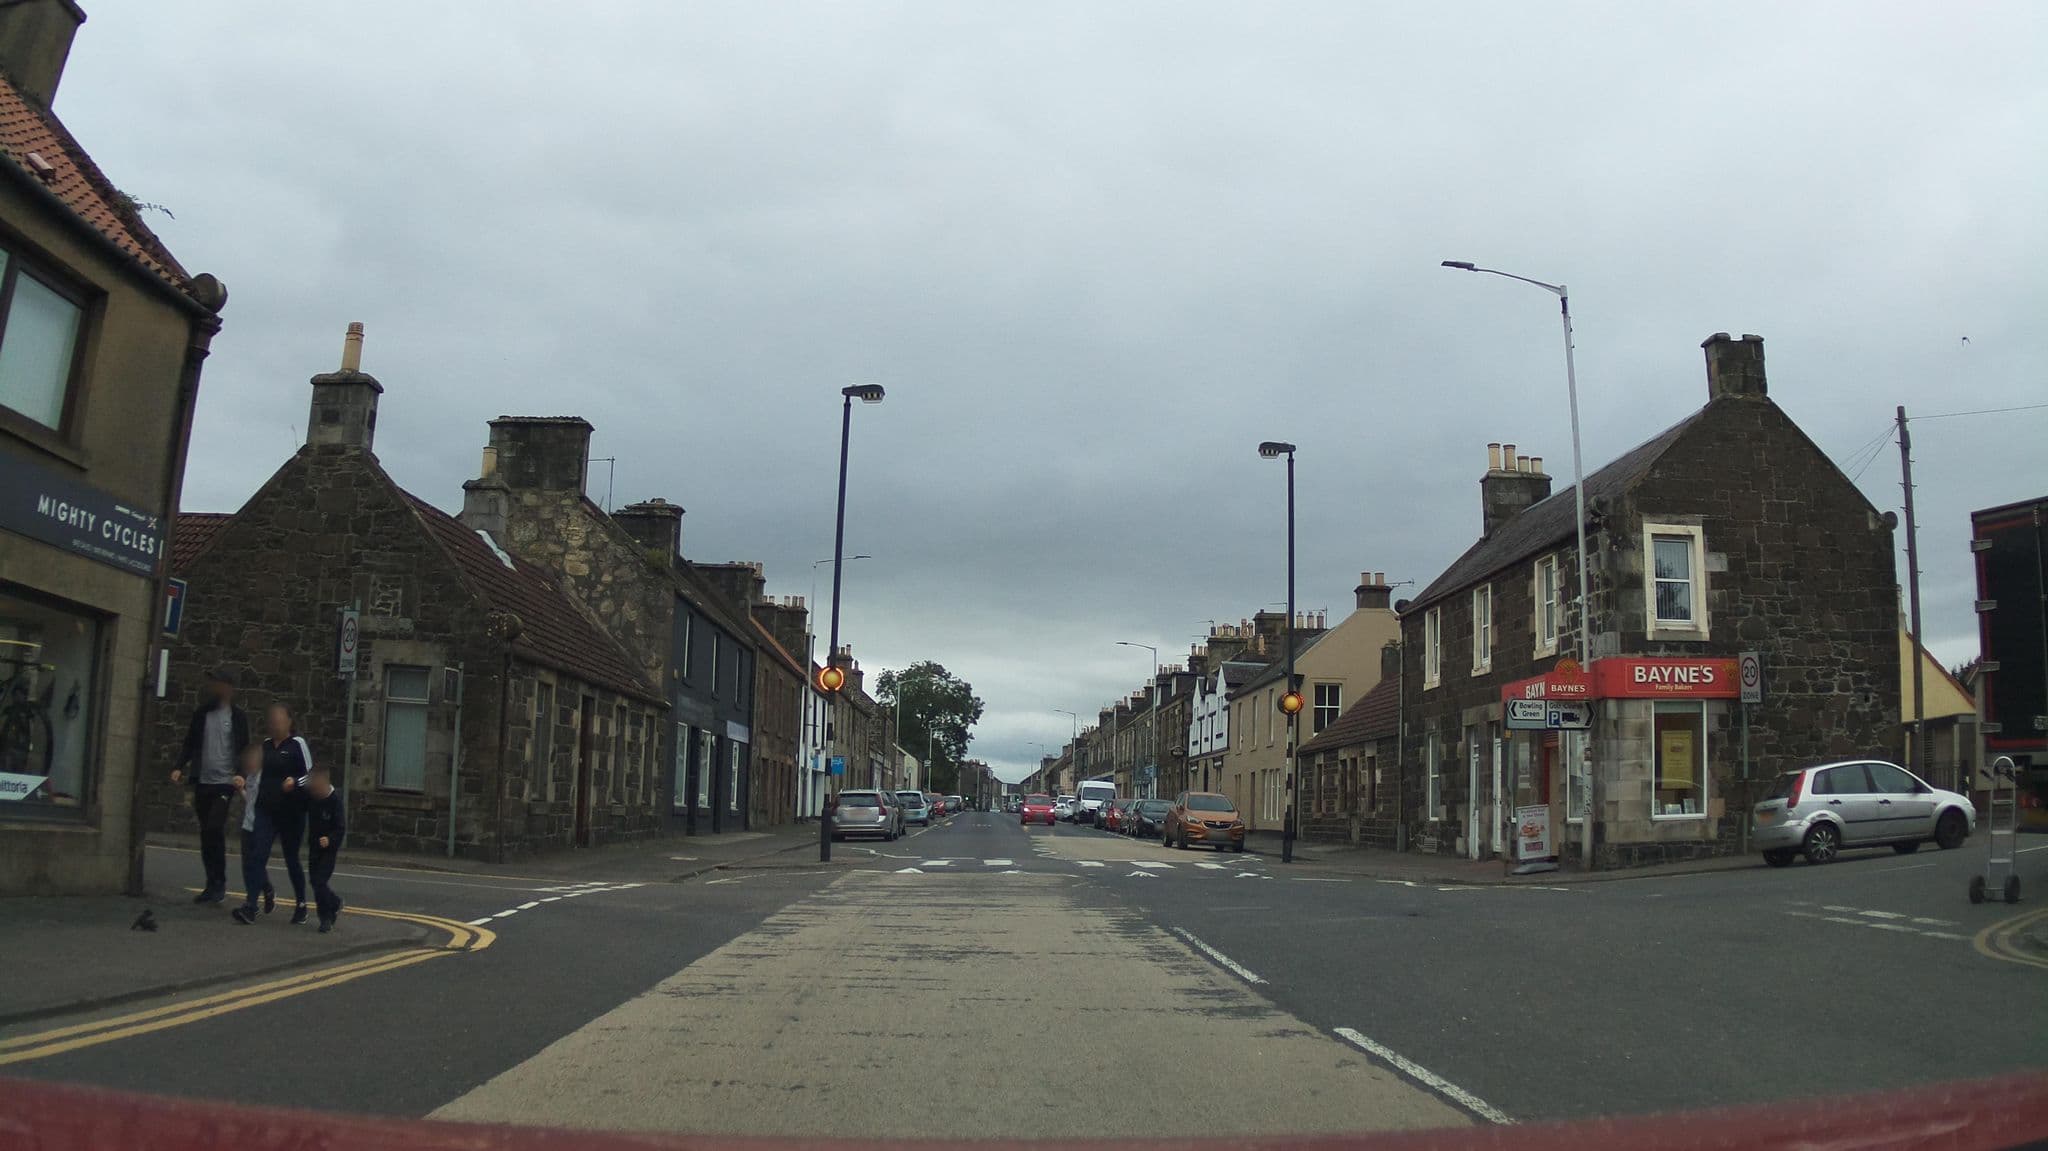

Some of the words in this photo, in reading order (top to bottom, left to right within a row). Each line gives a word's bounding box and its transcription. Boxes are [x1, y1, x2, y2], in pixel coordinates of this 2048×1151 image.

[37, 494, 97, 532] MIGHTY
[102, 519, 155, 555] CYCLES
[1634, 665, 1714, 683] BAYNE'S
[1744, 665, 1756, 679] 20
[1525, 681, 1546, 700] BAYN
[1655, 683, 1674, 691] Family
[1674, 683, 1693, 691] Bakers
[1519, 702, 1543, 711] Bowling
[1551, 712, 1559, 725] P
